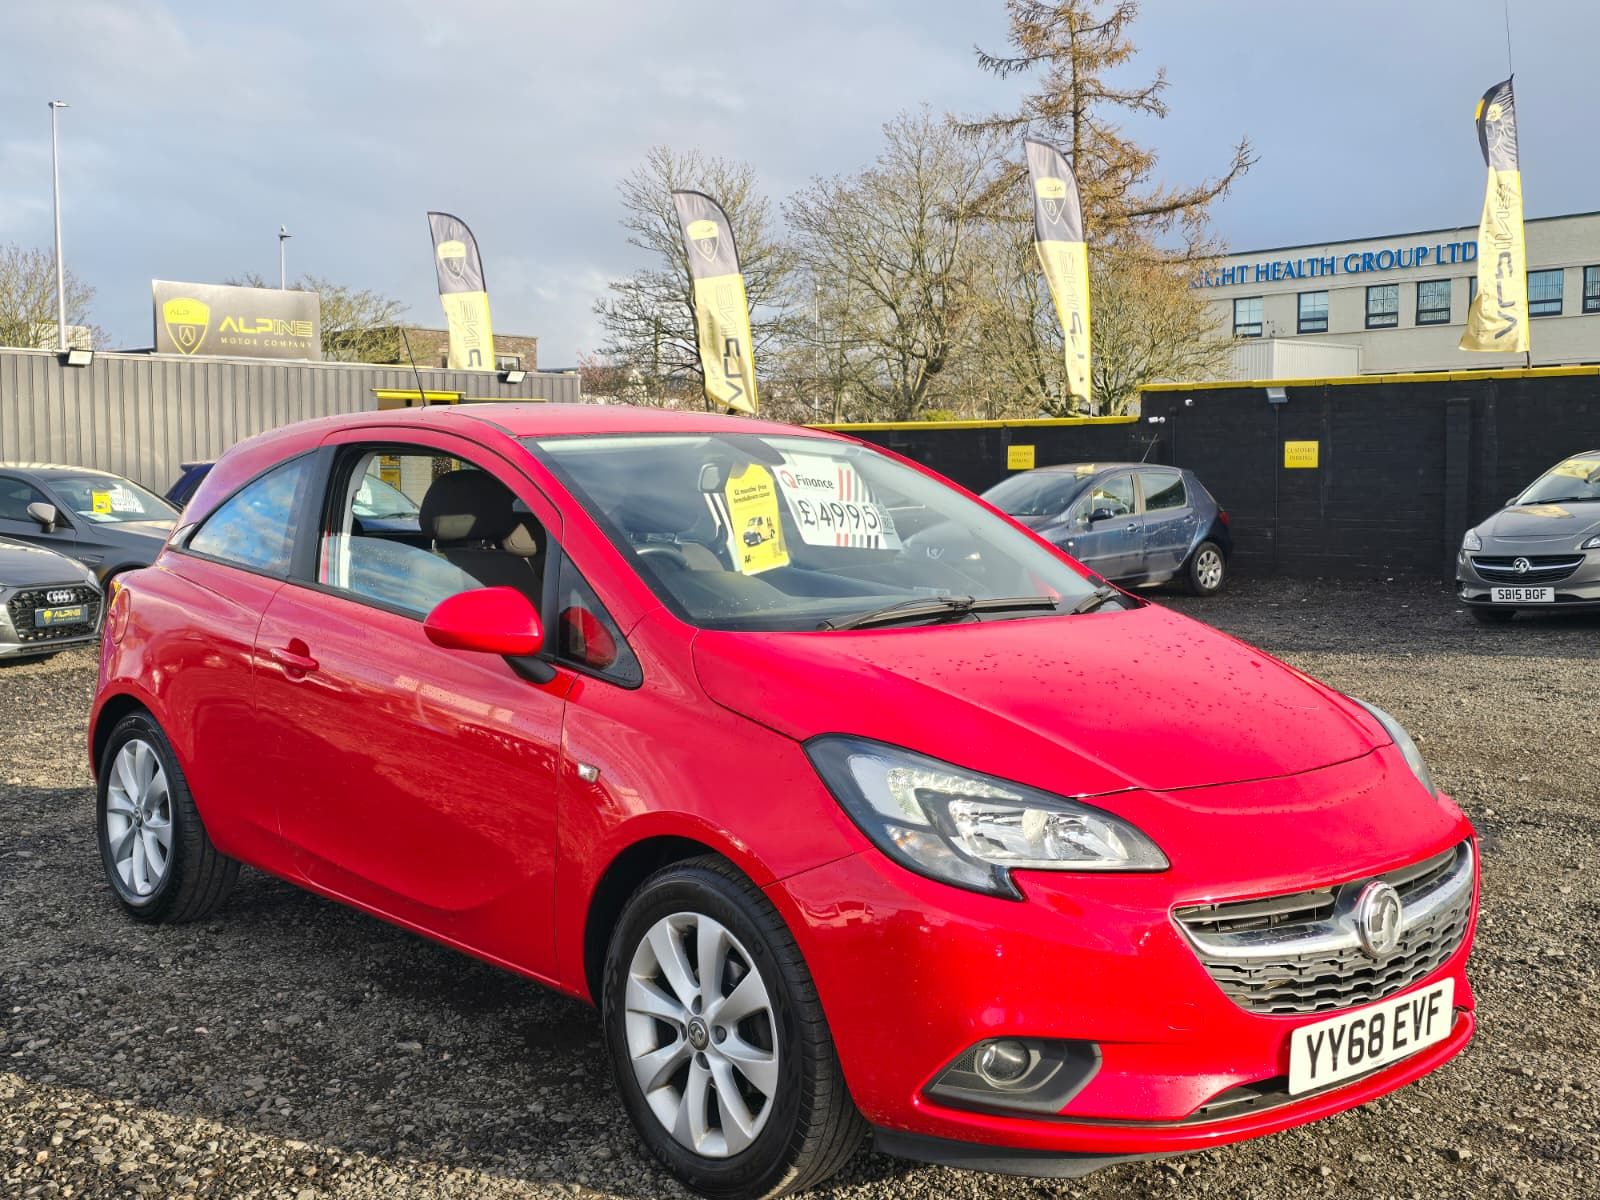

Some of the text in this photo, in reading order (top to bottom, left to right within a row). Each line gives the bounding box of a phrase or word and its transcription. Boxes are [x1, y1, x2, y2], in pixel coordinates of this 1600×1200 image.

[1256, 256, 1336, 282] HEALTH
[1343, 246, 1430, 273] GROUP
[1436, 241, 1479, 265] LTD
[219, 316, 313, 338] ALPINE
[220, 337, 313, 349] MOTOR COMPANY
[795, 474, 835, 490] Finance
[797, 499, 878, 530] £4995
[1498, 588, 1547, 600] SB15 BGF
[1306, 989, 1443, 1079] YY68 EVF
